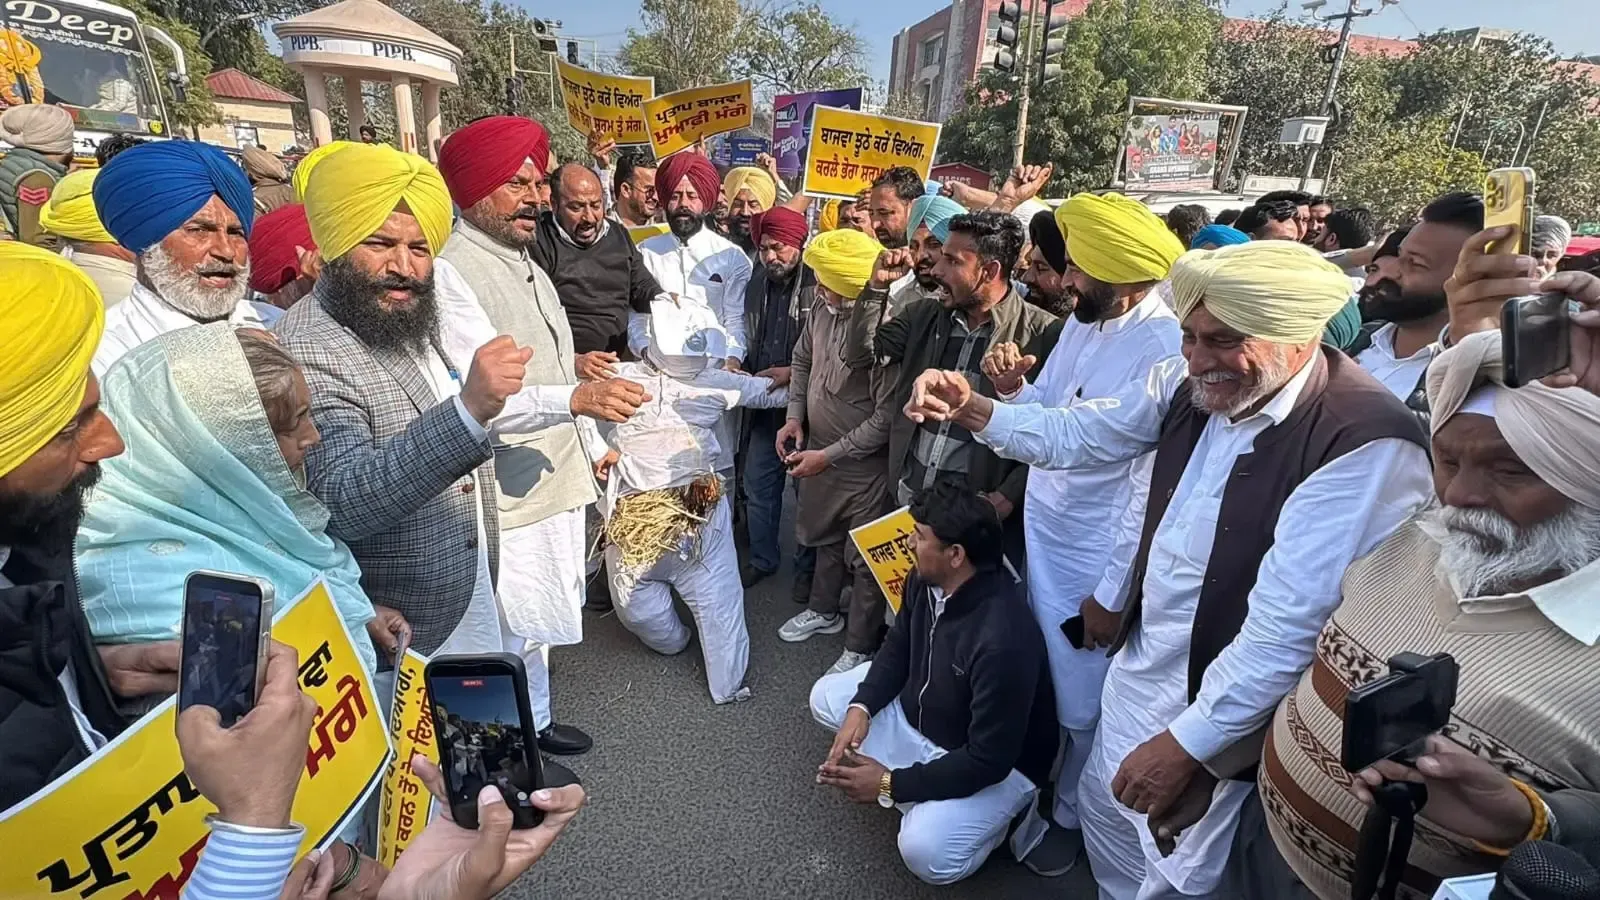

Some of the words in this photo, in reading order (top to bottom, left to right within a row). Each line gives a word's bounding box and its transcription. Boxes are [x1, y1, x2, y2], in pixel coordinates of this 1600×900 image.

[6, 1, 134, 46] Deep
[821, 127, 853, 149] ਬਾਜਵਾ
[854, 127, 872, 158] ਝੂਠੇ
[867, 541, 897, 565] ਬਾਜਵਾ
[396, 797, 417, 842] ਕਰਨ
